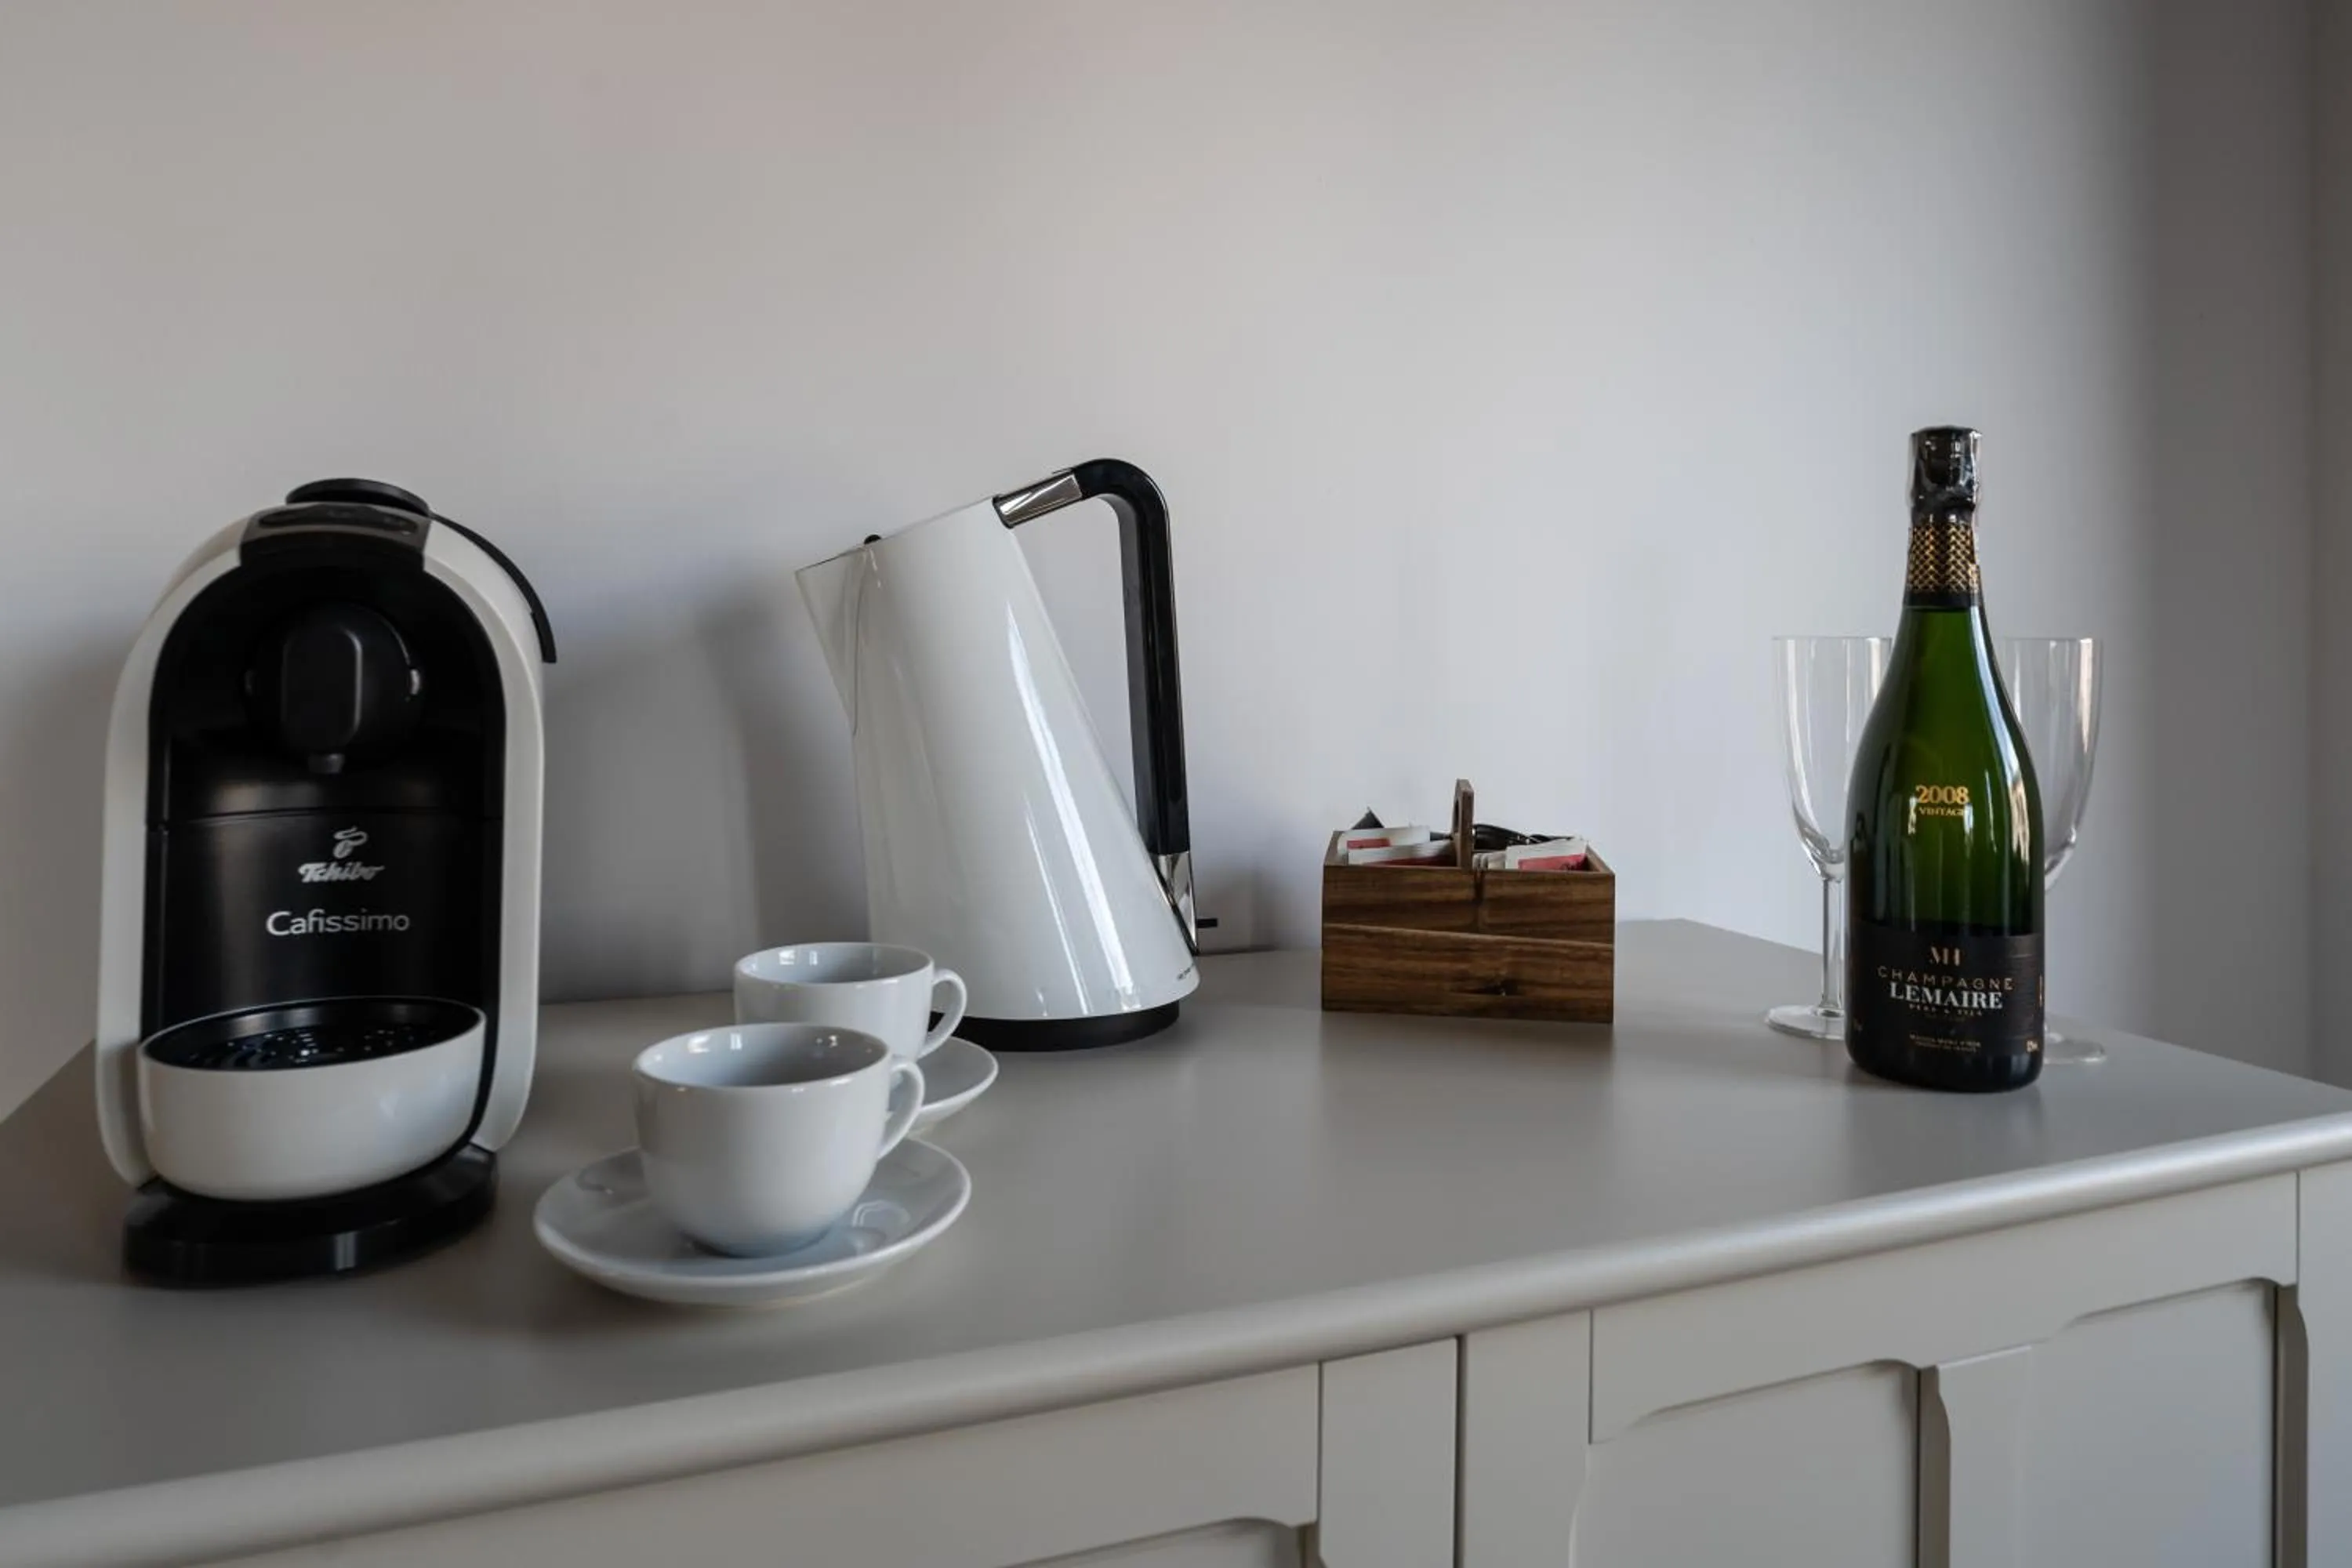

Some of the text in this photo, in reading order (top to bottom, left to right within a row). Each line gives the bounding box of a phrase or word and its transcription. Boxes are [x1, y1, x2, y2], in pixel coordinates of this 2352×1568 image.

[1915, 785, 1969, 804] 2008
[297, 862, 385, 883] Tchibo
[266, 909, 410, 936] Cafissimo
[1876, 965, 2014, 991] CHAMPAGNE
[1889, 981, 2002, 1010] LEMAIRE
